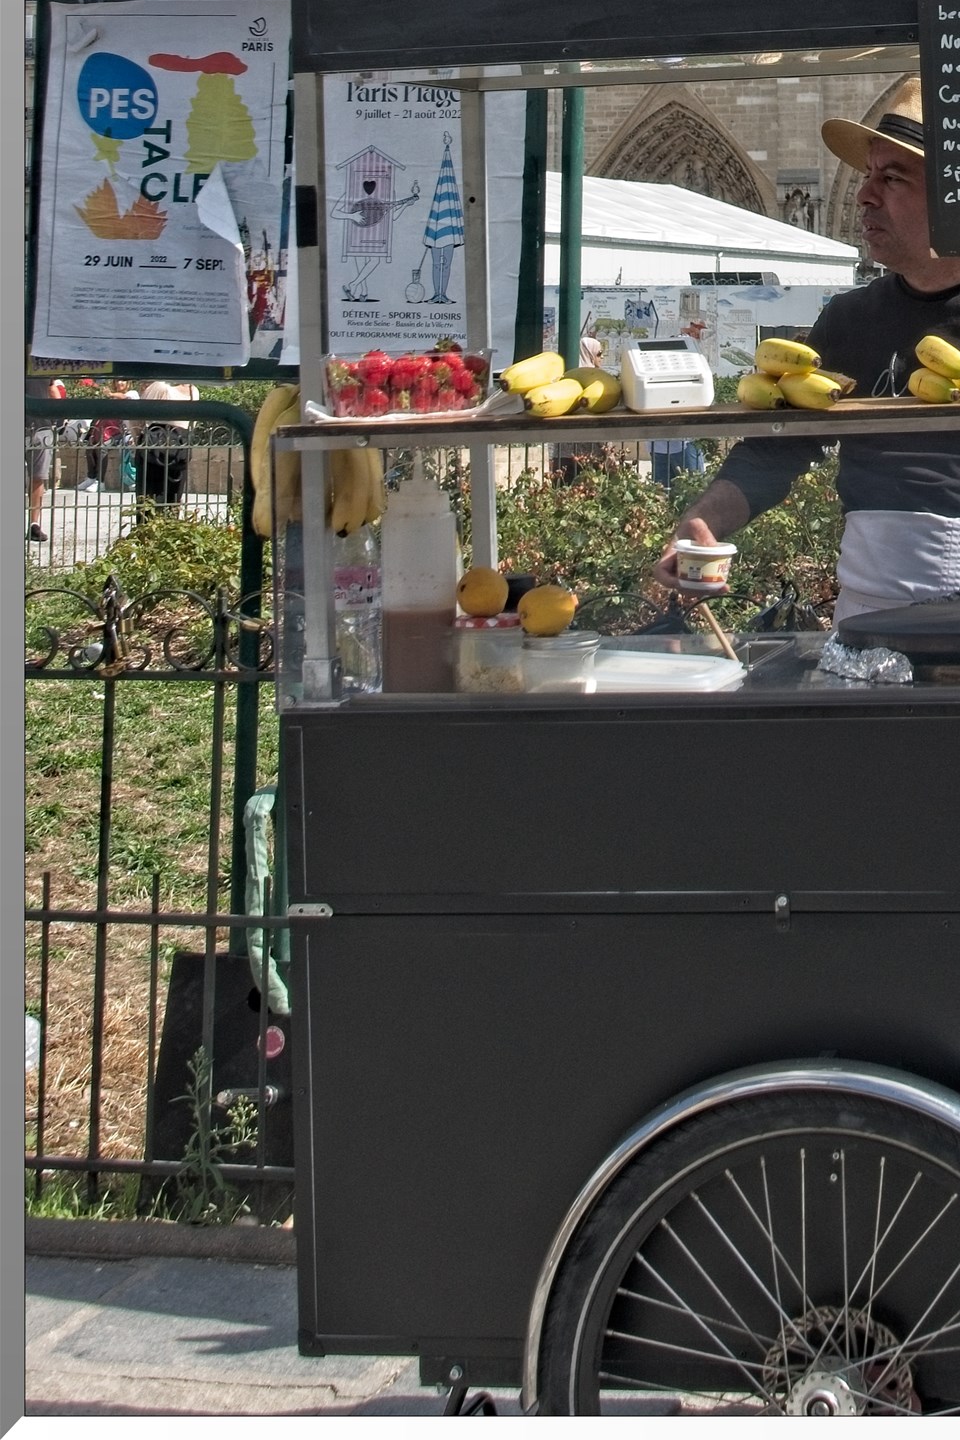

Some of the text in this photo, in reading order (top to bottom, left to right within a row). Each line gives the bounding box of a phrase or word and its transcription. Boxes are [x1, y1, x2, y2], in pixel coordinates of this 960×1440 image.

[241, 42, 274, 51] PARIS
[89, 87, 156, 120] PES
[355, 109, 363, 119] 9
[364, 109, 391, 120] juillet
[402, 109, 413, 119] 21
[414, 109, 436, 119] août
[84, 255, 102, 267] 29
[103, 256, 134, 268] JUIN
[150, 255, 168, 263] 2022
[183, 258, 192, 269] 7
[342, 310, 462, 321] DÉTENTE SPORTS LOISIRS
[328, 330, 346, 338] OUT
[355, 331, 401, 339] PROGRAMME
